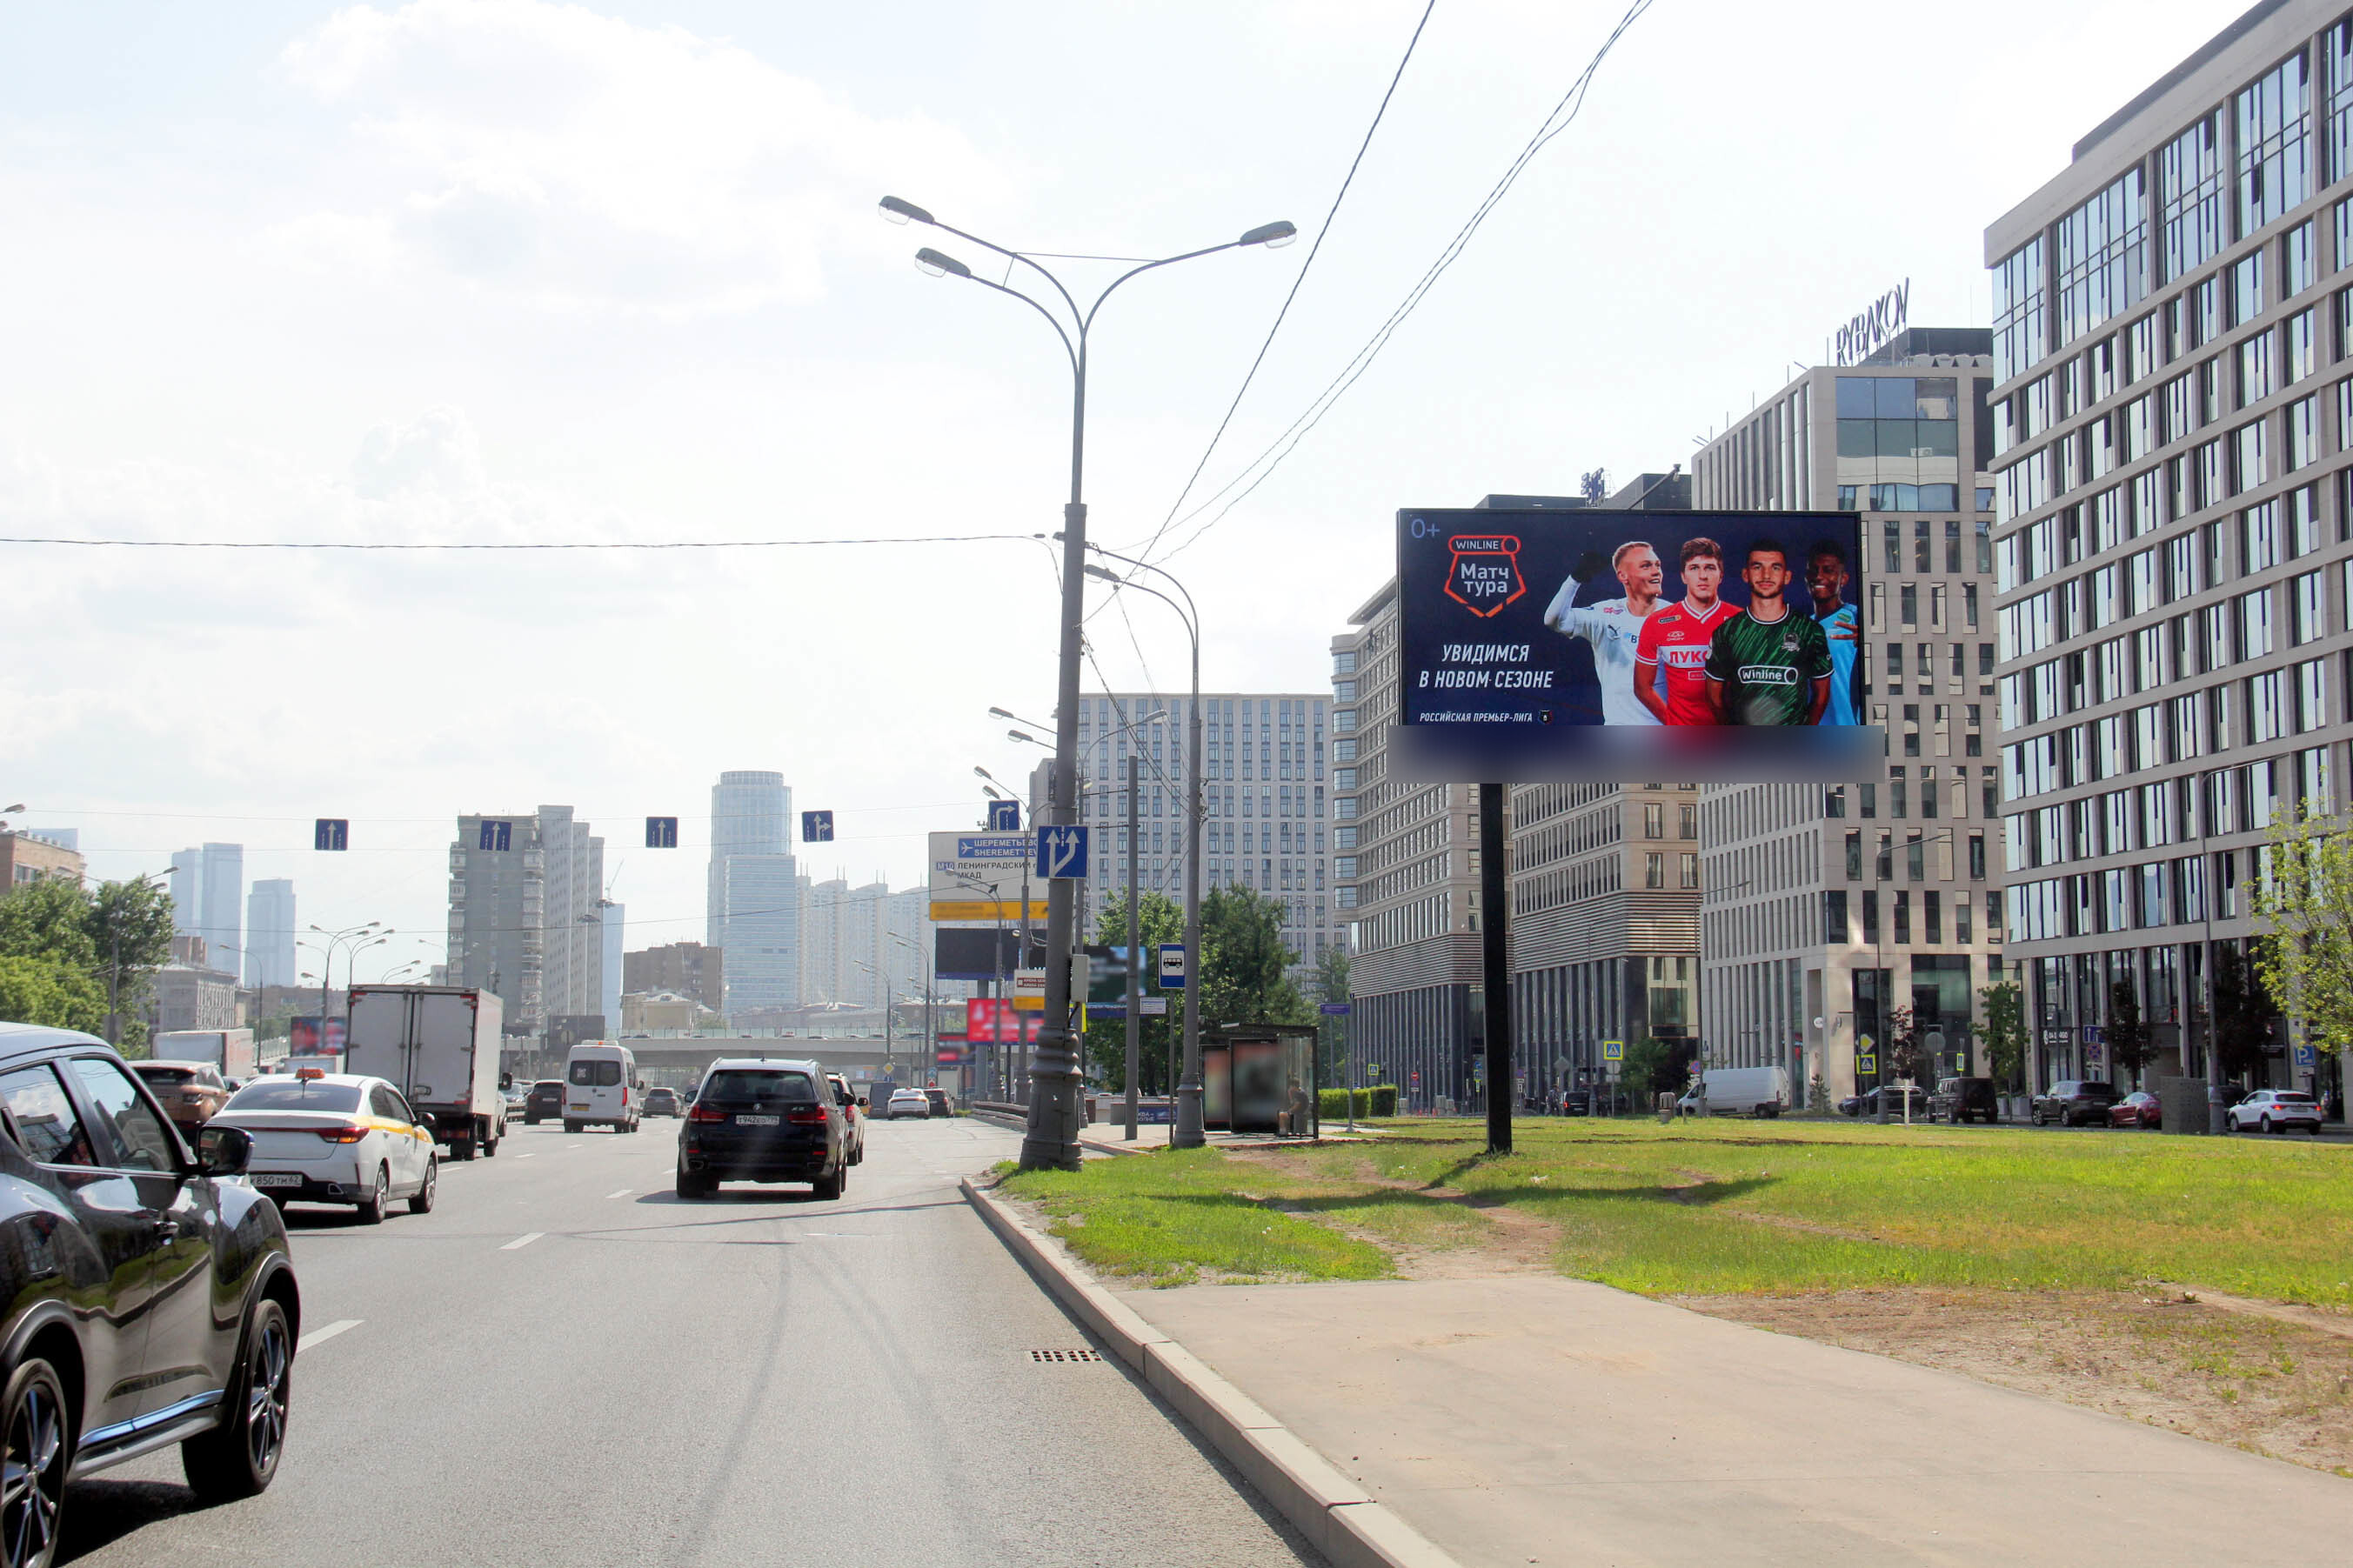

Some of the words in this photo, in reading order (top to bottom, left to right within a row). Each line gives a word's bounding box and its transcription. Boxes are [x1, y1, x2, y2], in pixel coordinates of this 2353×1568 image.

[1836, 277, 1909, 366] RYBAKOV
[1411, 518, 1441, 538] 0+
[1455, 540, 1499, 550] WINLINE
[1461, 563, 1509, 579] Матч
[1463, 580, 1508, 597] тура
[1441, 644, 1530, 664] УВИДИМСЯ
[1419, 671, 1429, 688] В
[1434, 671, 1489, 688] НОВОМ
[1494, 671, 1554, 688] СЕЗОНЕ
[1741, 669, 1782, 680] Winline
[1420, 711, 1471, 722] РОССИЙСКАЯ
[1473, 712, 1533, 722] ПРЕМЬЕР-ЛИГА
